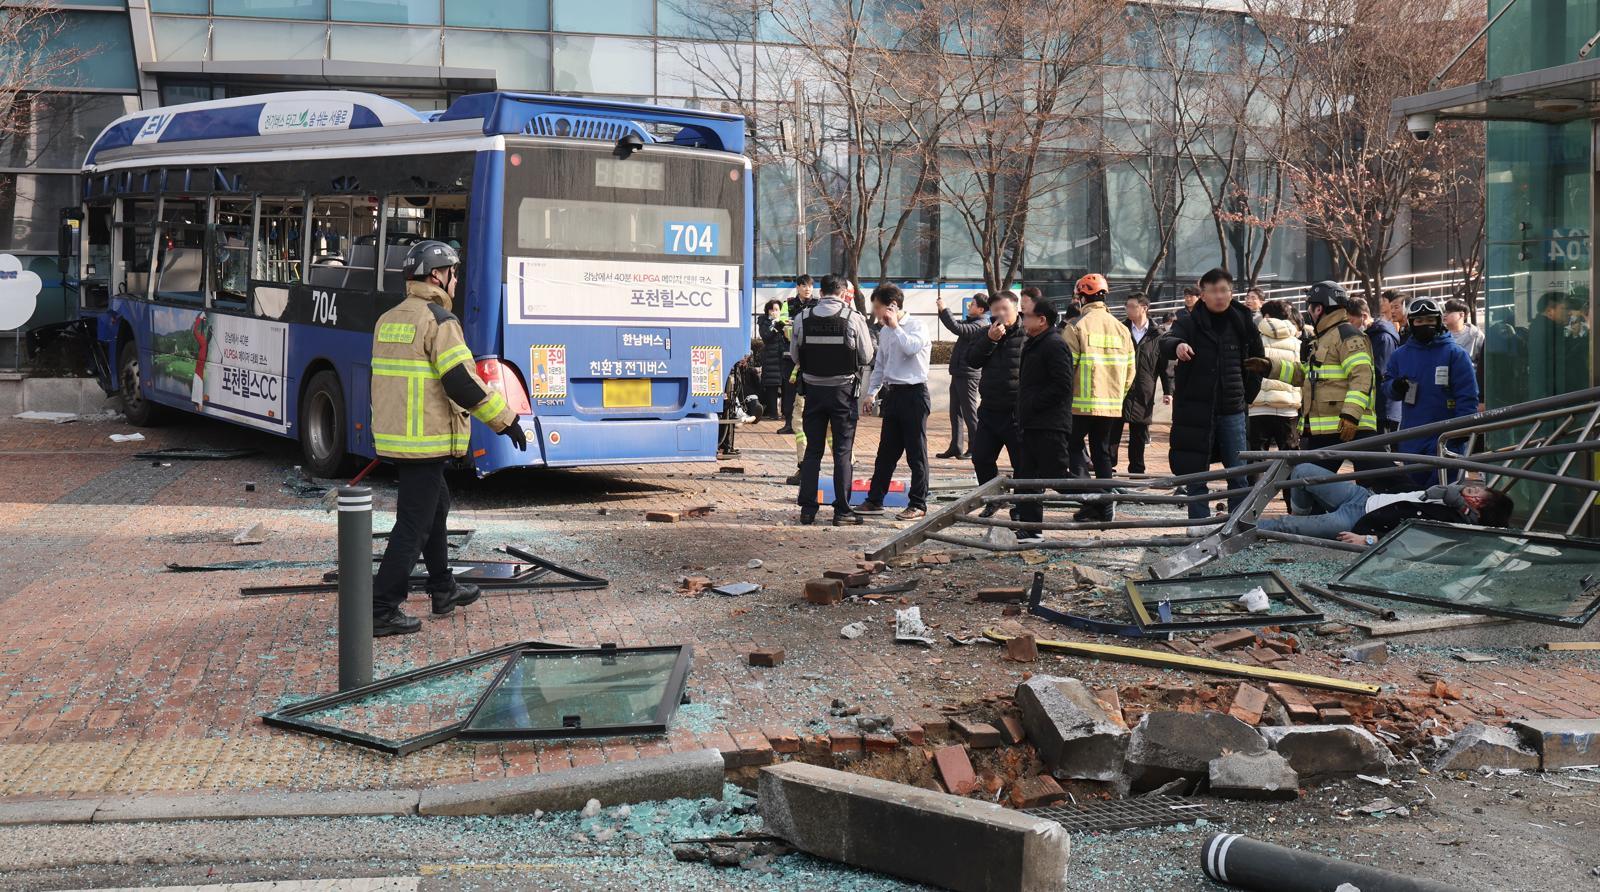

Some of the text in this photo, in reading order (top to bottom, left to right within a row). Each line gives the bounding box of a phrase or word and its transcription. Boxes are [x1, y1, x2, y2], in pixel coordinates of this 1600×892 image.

[143, 113, 172, 135] EV
[329, 109, 348, 126] 서울로
[671, 224, 713, 253] 704
[584, 272, 613, 282] 강남에서
[614, 273, 632, 283] 40분
[633, 274, 660, 282] KLPGA
[631, 288, 712, 308] 포천힐스CC
[312, 290, 337, 325] 704
[622, 333, 663, 346] 한남버스
[224, 348, 238, 360] KLPGA
[548, 348, 565, 365] 주의
[692, 350, 707, 365] 주의
[590, 359, 668, 376] 친환경 전기버스
[222, 367, 277, 401] 포천힐스CC
